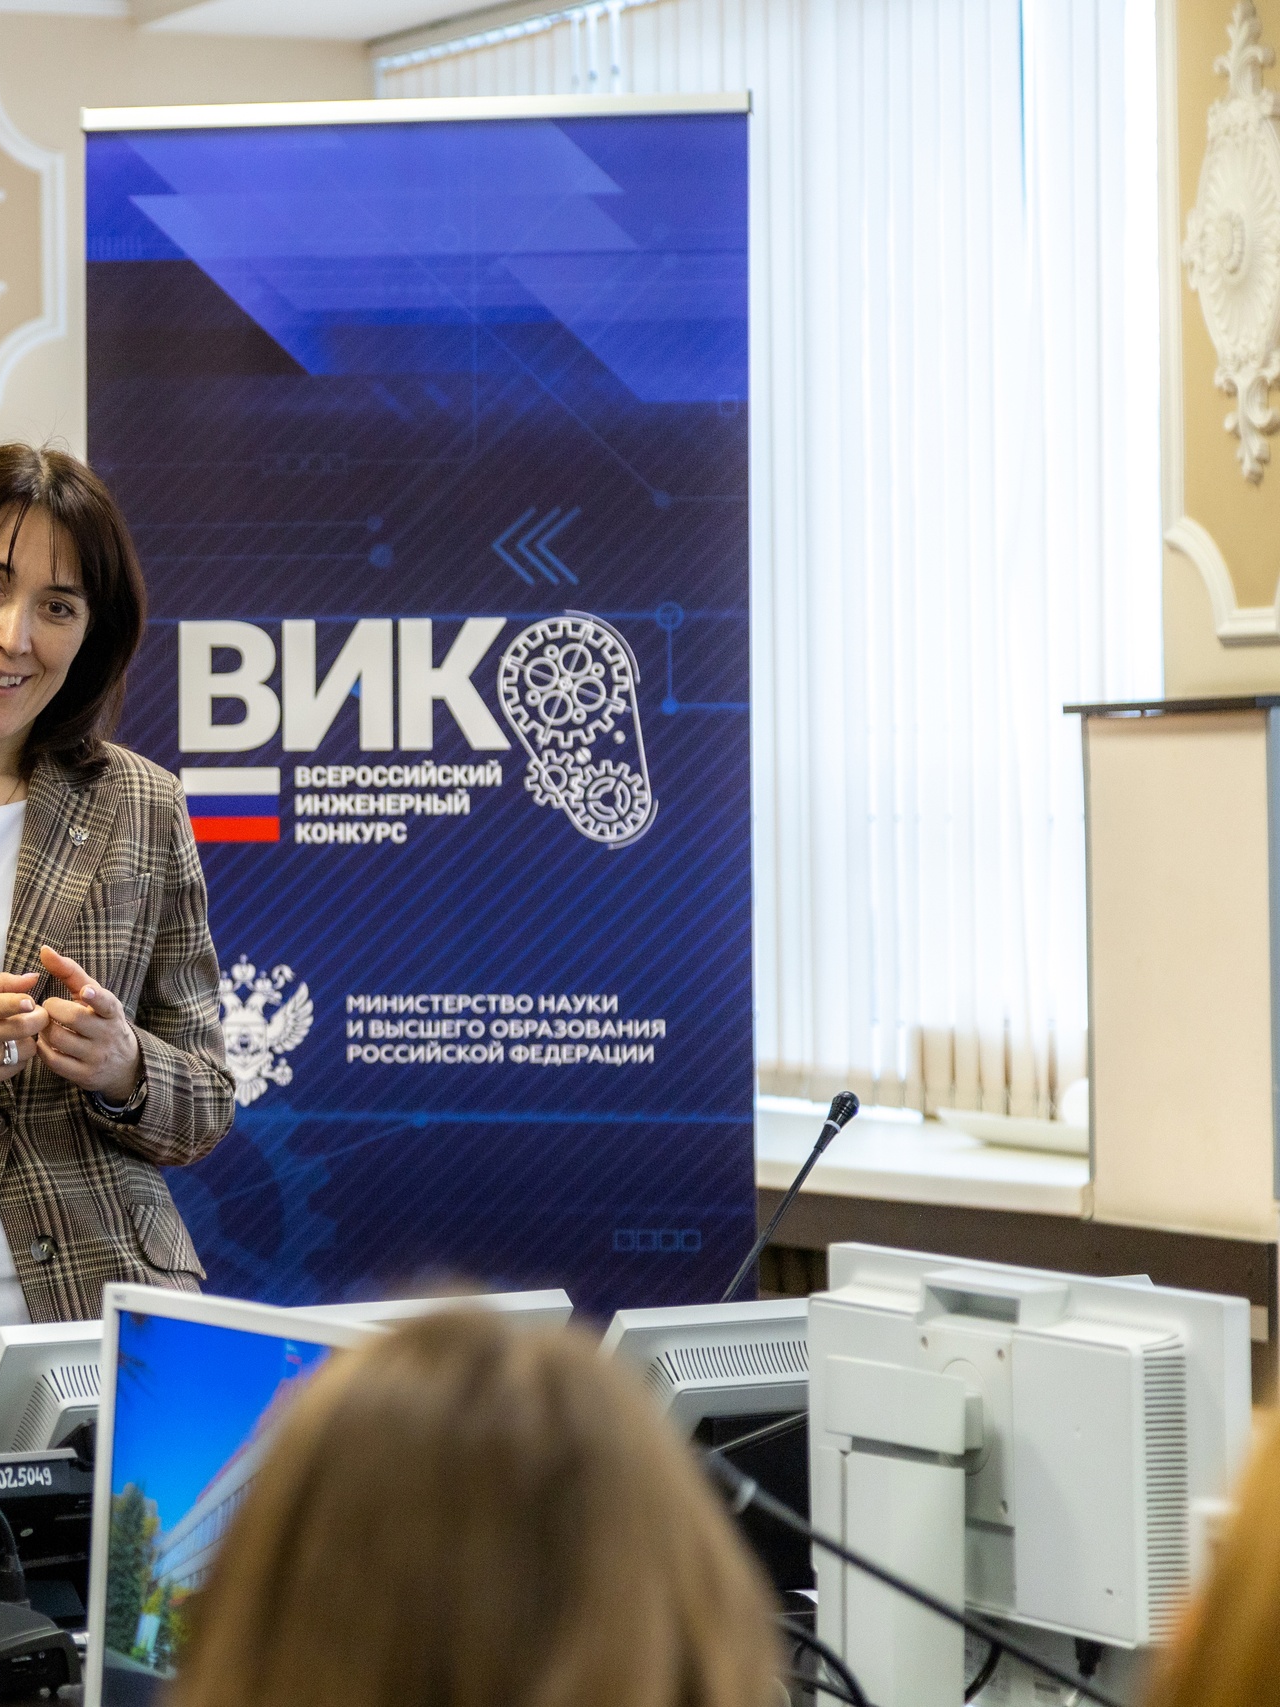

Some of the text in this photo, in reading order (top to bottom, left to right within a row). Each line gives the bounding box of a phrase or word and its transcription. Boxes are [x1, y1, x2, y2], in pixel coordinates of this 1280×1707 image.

[179, 617, 511, 752] ВИК
[294, 759, 503, 788] ВСЕРОССИЙСКИЙ
[294, 789, 471, 816] ИНЖЕНЕРНЫЙ
[294, 821, 408, 845] КОНКУРС
[345, 993, 619, 1015] МИНИСТЕРСТВО НАУКИ
[345, 1017, 667, 1040] И ВЫСШЕГО ОБРАЗОВАНИЯ
[346, 1041, 656, 1066] РОССИЙСКОЙ ФЕДЕРАЦИИ
